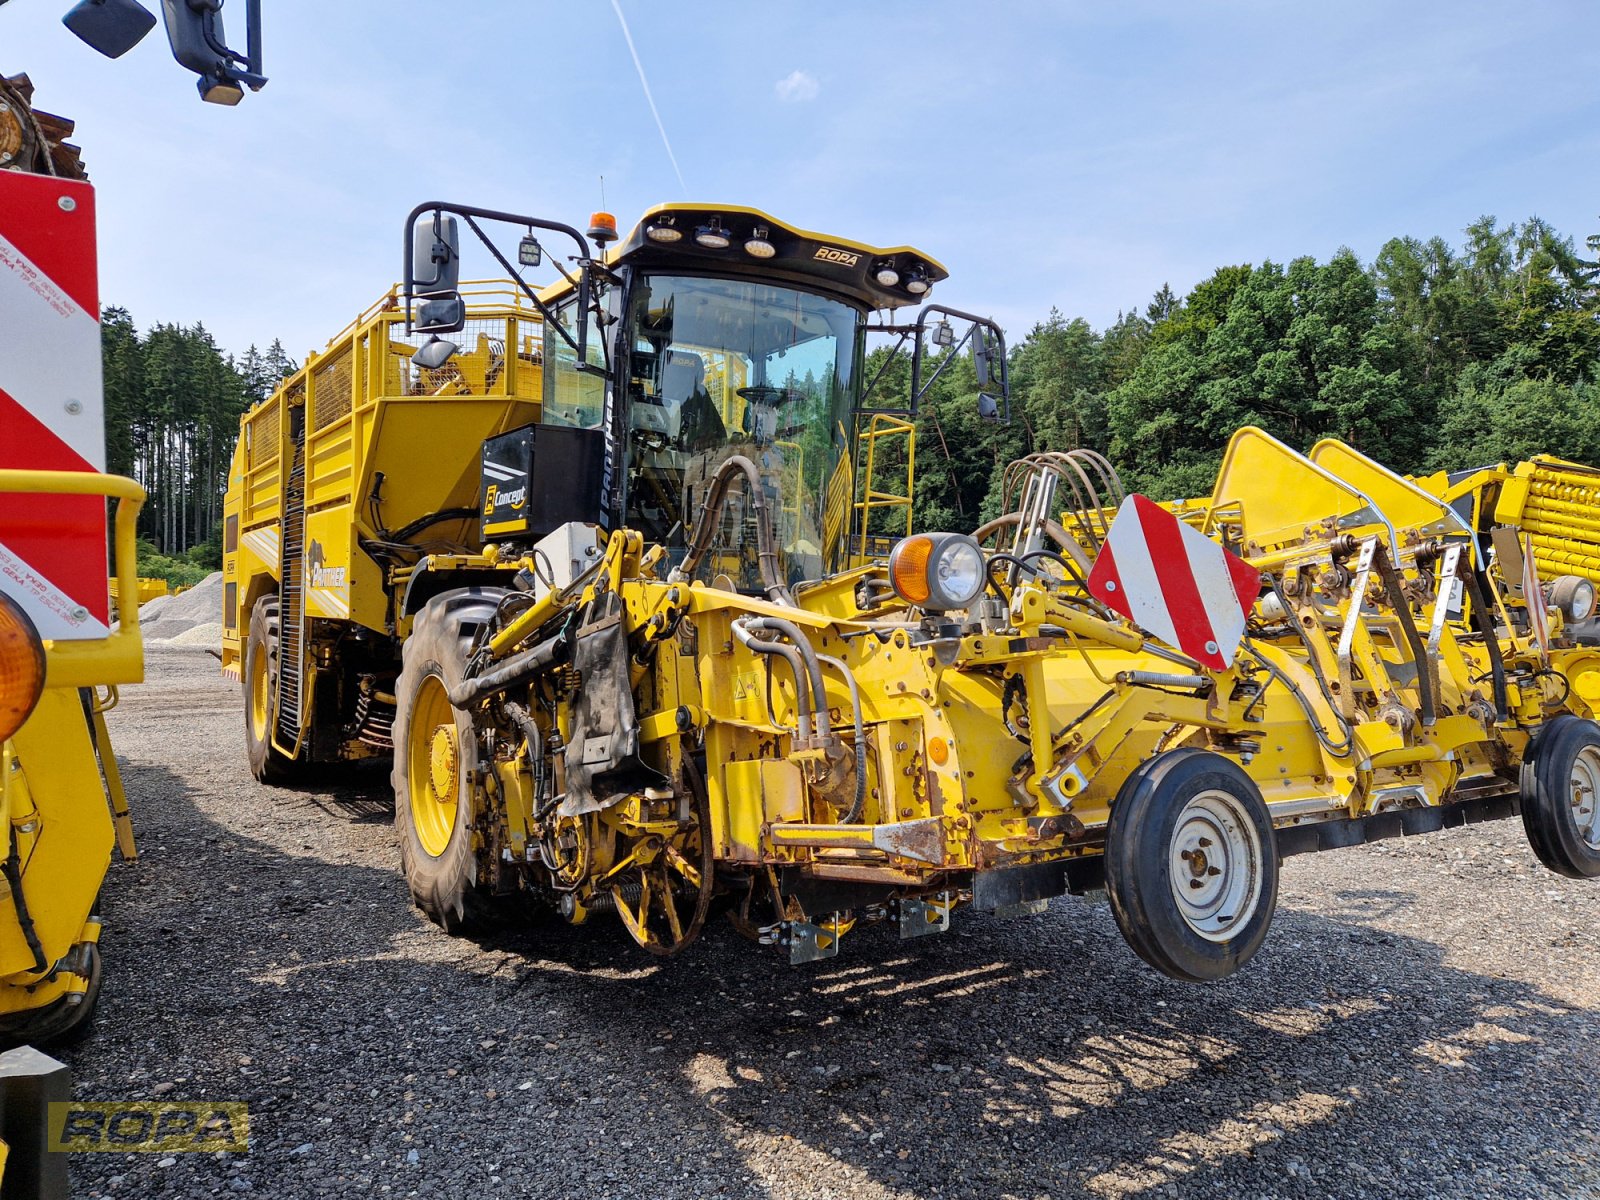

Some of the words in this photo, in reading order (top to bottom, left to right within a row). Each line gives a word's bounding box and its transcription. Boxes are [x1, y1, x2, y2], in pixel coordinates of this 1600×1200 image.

[815, 247, 858, 266] ROPA
[16, 258, 37, 279] GEKA
[494, 485, 526, 507] Concept
[2, 566, 24, 586] GEKA
[25, 572, 47, 592] GEKA
